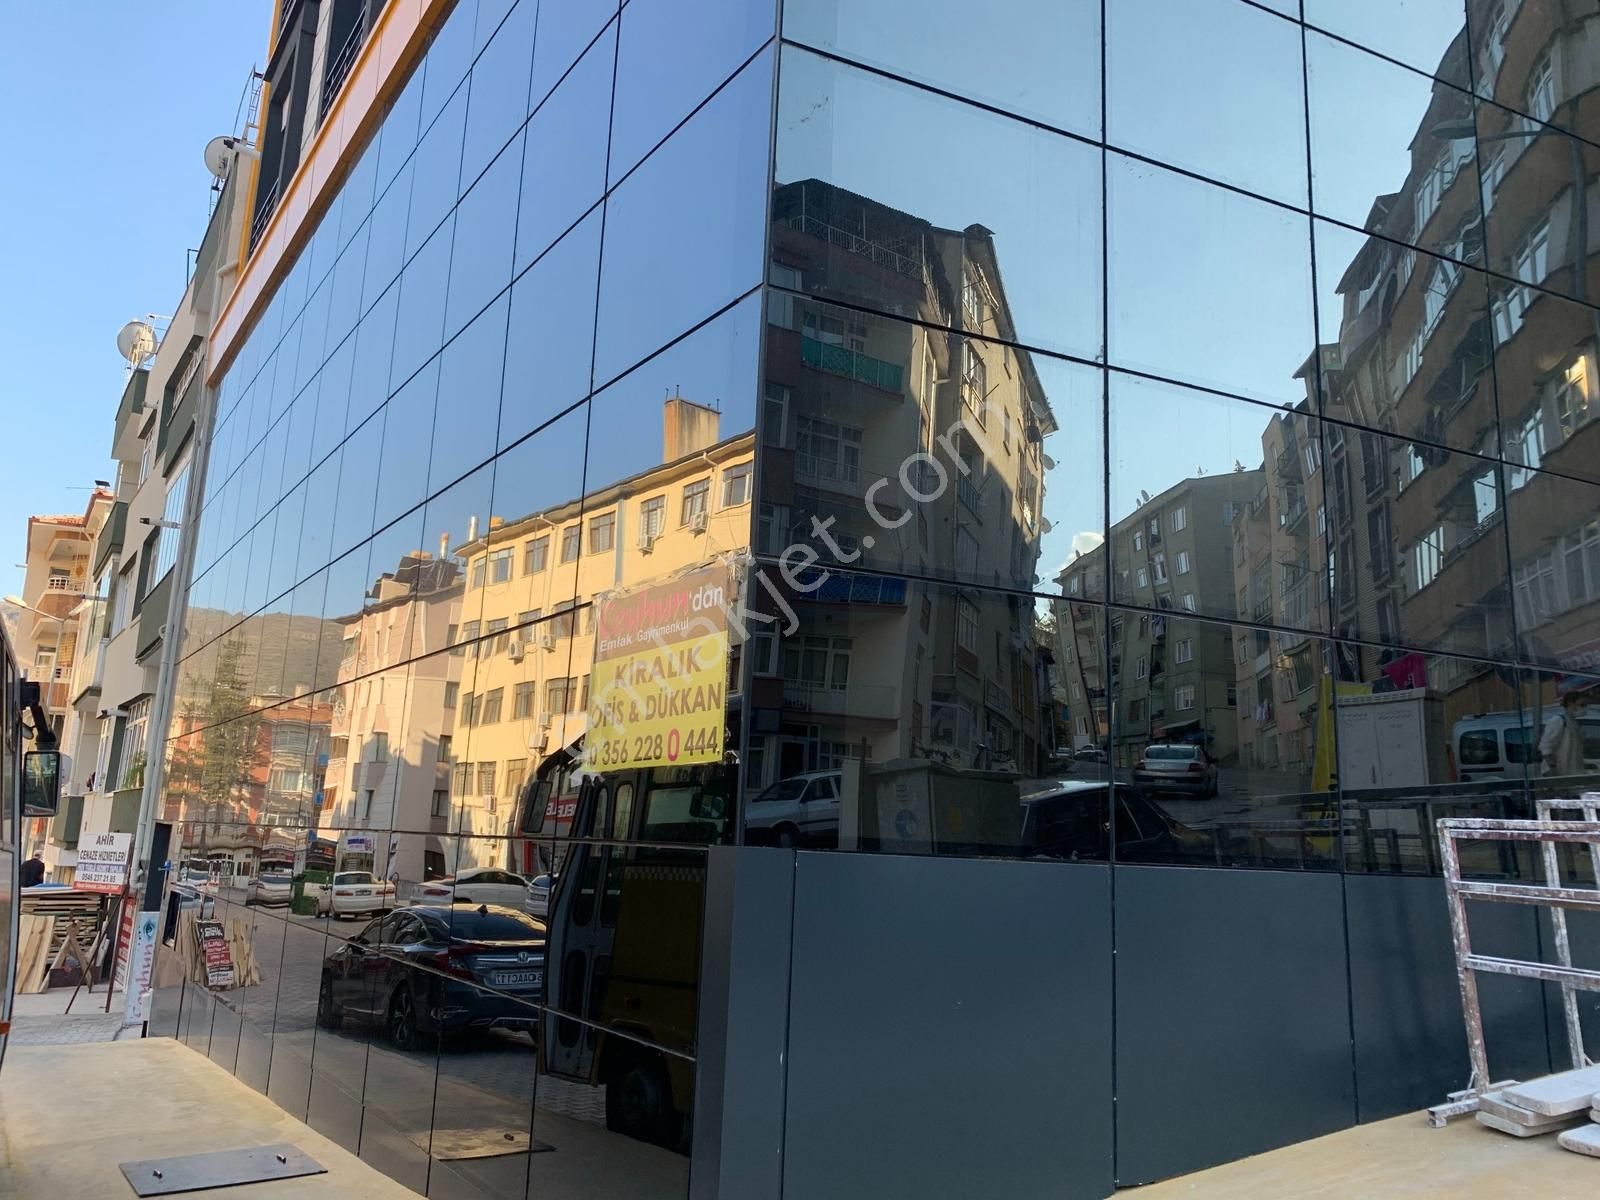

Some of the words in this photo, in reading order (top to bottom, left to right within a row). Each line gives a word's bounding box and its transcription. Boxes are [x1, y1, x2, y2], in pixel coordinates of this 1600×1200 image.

[600, 635, 632, 652] Emlak
[637, 618, 689, 642] Gayrimenkul
[614, 646, 702, 689] KİRALIK
[591, 696, 624, 728] OFİS
[629, 701, 639, 722] &
[645, 682, 722, 721] DÜKKAN
[602, 738, 628, 765] 356
[633, 733, 663, 762] 228
[667, 728, 681, 762] 0
[80, 850, 98, 860] CENAZE
